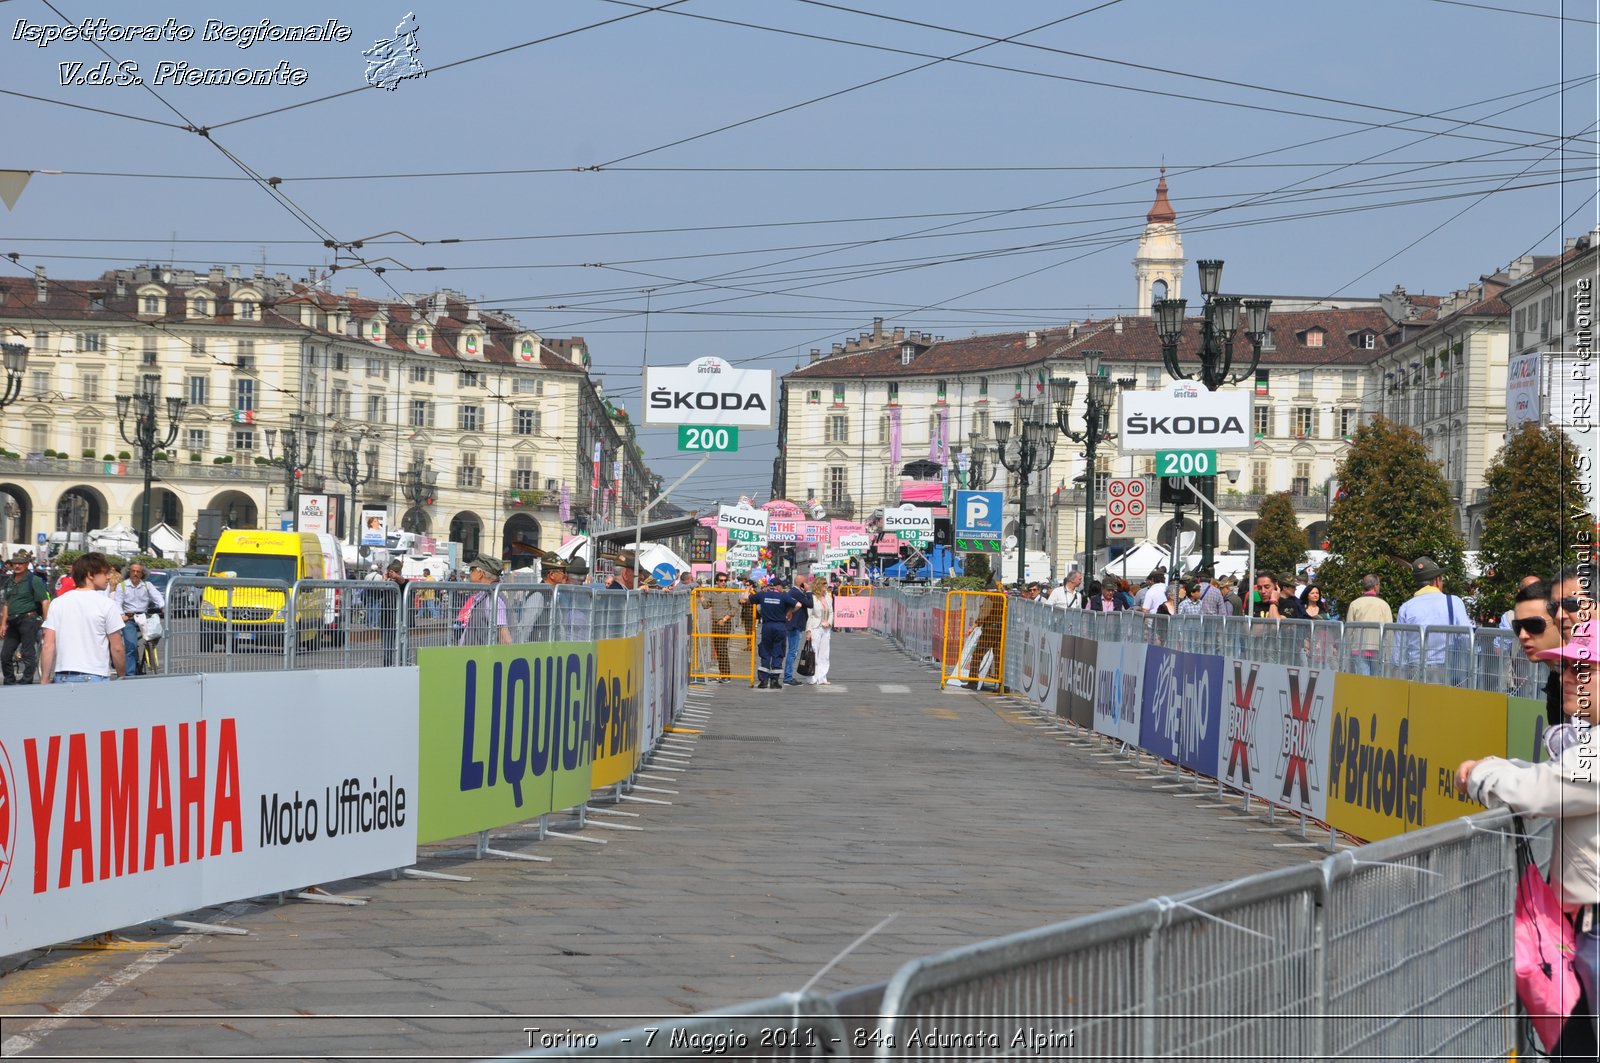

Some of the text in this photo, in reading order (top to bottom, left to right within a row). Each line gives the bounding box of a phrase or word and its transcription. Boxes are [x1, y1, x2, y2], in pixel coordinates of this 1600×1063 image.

[650, 386, 766, 411] ŠKODA
[1126, 412, 1245, 435] ŠKODA
[685, 428, 729, 450] 200
[1164, 453, 1208, 474] 200
[1132, 485, 1140, 493] 10
[720, 512, 764, 527] ŠKODA
[886, 516, 930, 525] ŠKODA
[733, 530, 749, 540] 150
[899, 530, 916, 539] 150
[913, 540, 926, 548] 125
[460, 652, 595, 808] LIQUIGA
[1228, 702, 1256, 748] BRUX
[1282, 713, 1316, 765] BRUX
[1345, 713, 1428, 826] Bricofer
[1438, 767, 1455, 799] FAI
[23, 717, 243, 895] YAMAHA
[259, 775, 407, 848] Moto Ufficiale
